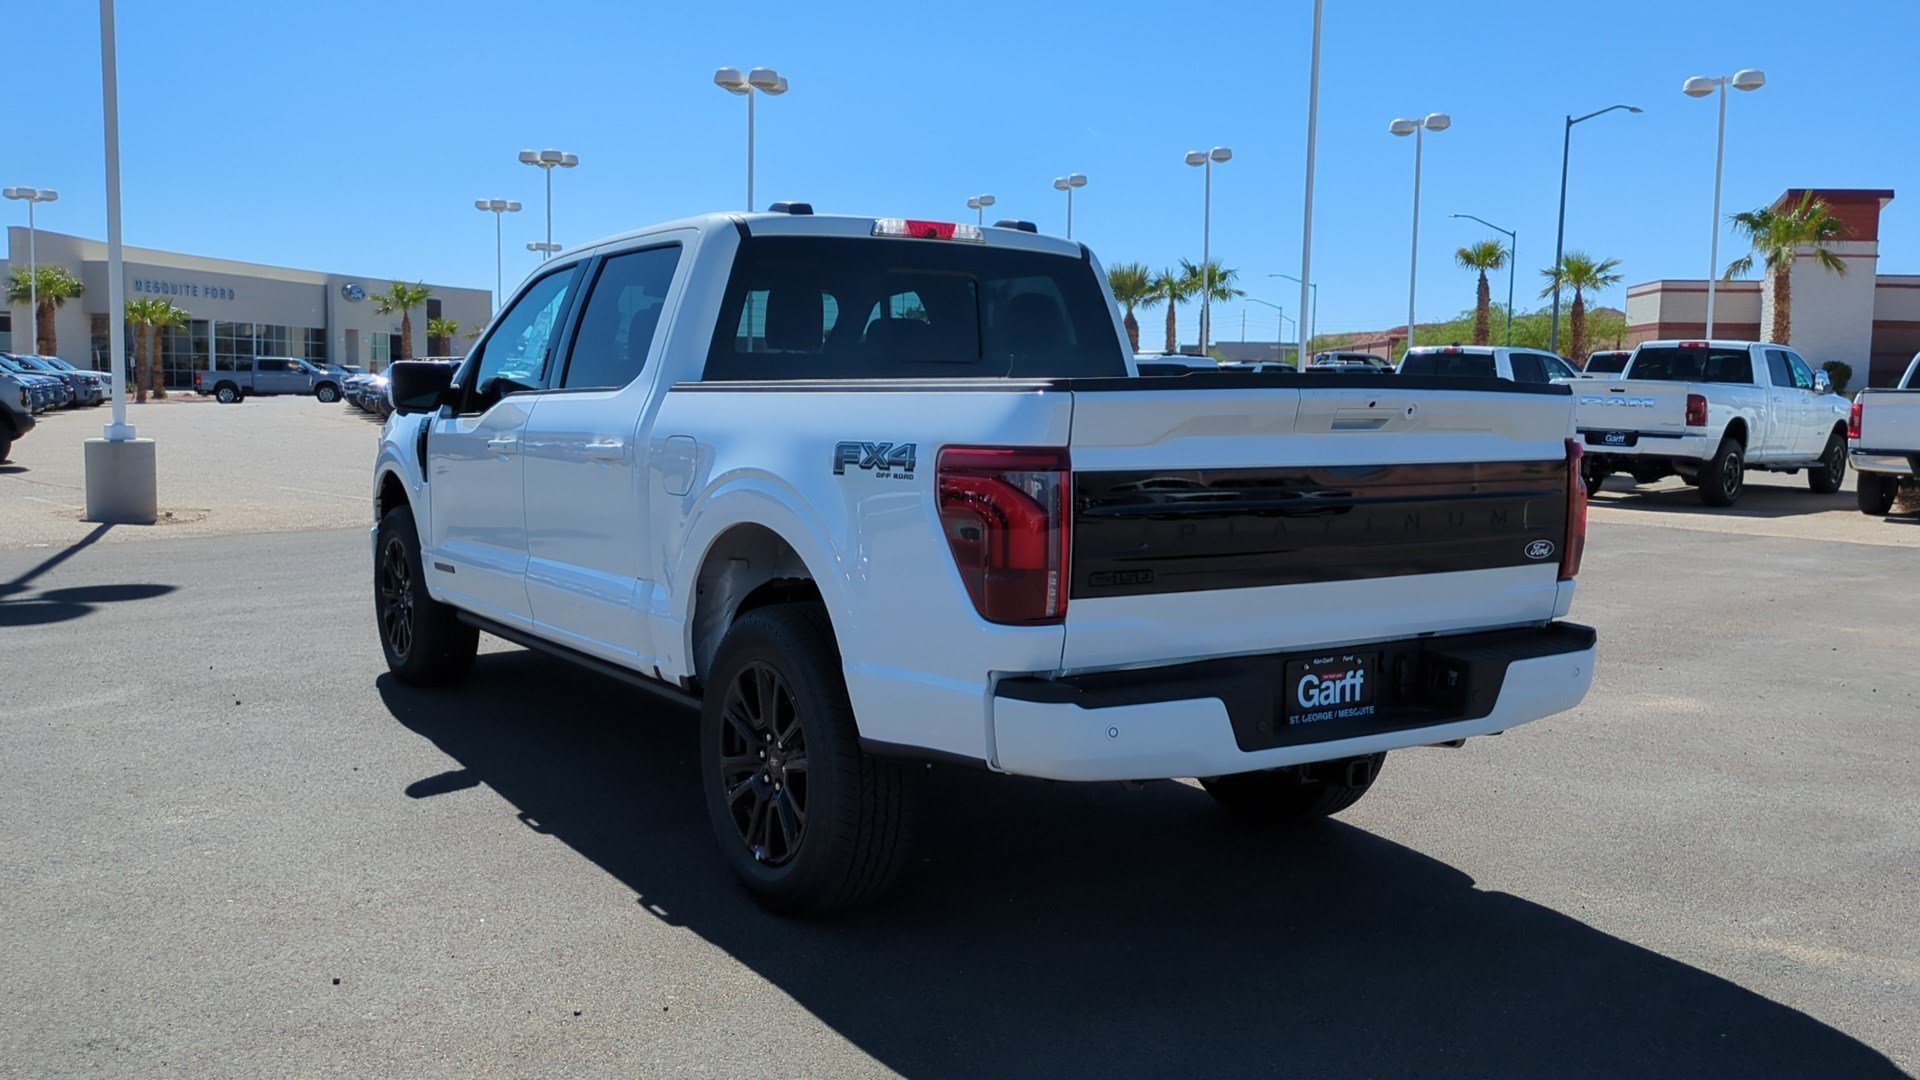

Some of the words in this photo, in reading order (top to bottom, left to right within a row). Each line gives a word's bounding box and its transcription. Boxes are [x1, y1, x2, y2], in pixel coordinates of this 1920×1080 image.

[135, 279, 198, 297] MESQUITE
[204, 286, 235, 300] FORD
[1580, 396, 1654, 408] RAM
[833, 441, 917, 475] FX4
[1178, 509, 1507, 541] PLATINUM
[1530, 543, 1550, 555] Ford
[1297, 669, 1364, 708] Garff
[1289, 715, 1300, 724] ST.
[1302, 711, 1333, 722] GEORGE
[1338, 706, 1375, 718] MESQUITE
